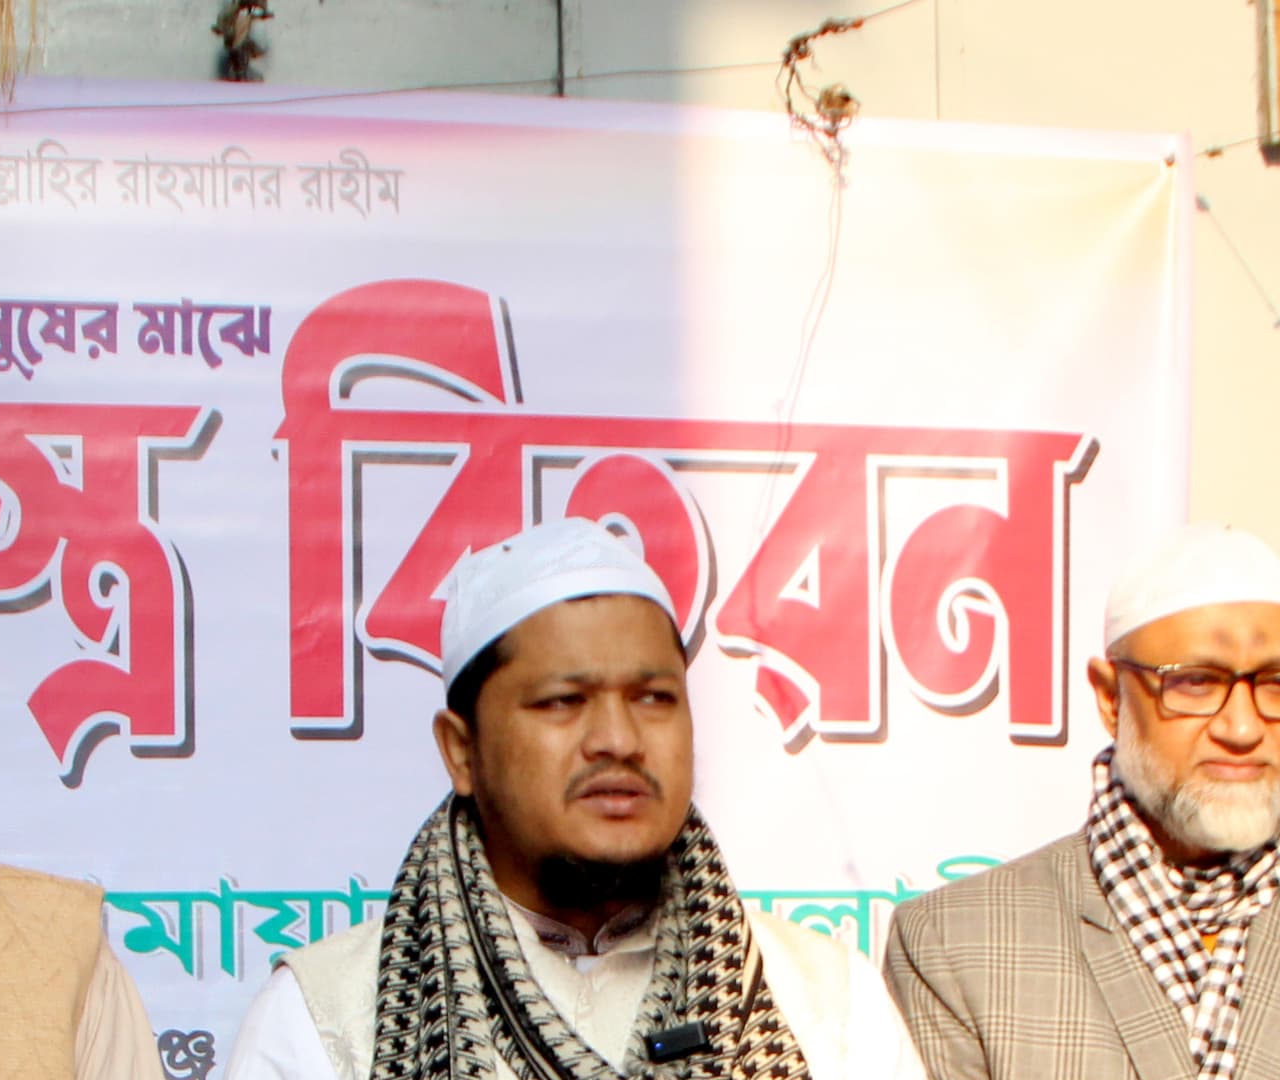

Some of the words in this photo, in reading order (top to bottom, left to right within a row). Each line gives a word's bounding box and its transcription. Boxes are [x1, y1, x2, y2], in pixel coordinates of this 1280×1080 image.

[113, 146, 287, 212] রাহমানির
[296, 146, 405, 215] রাহীম
[132, 296, 273, 369] মাঝে
